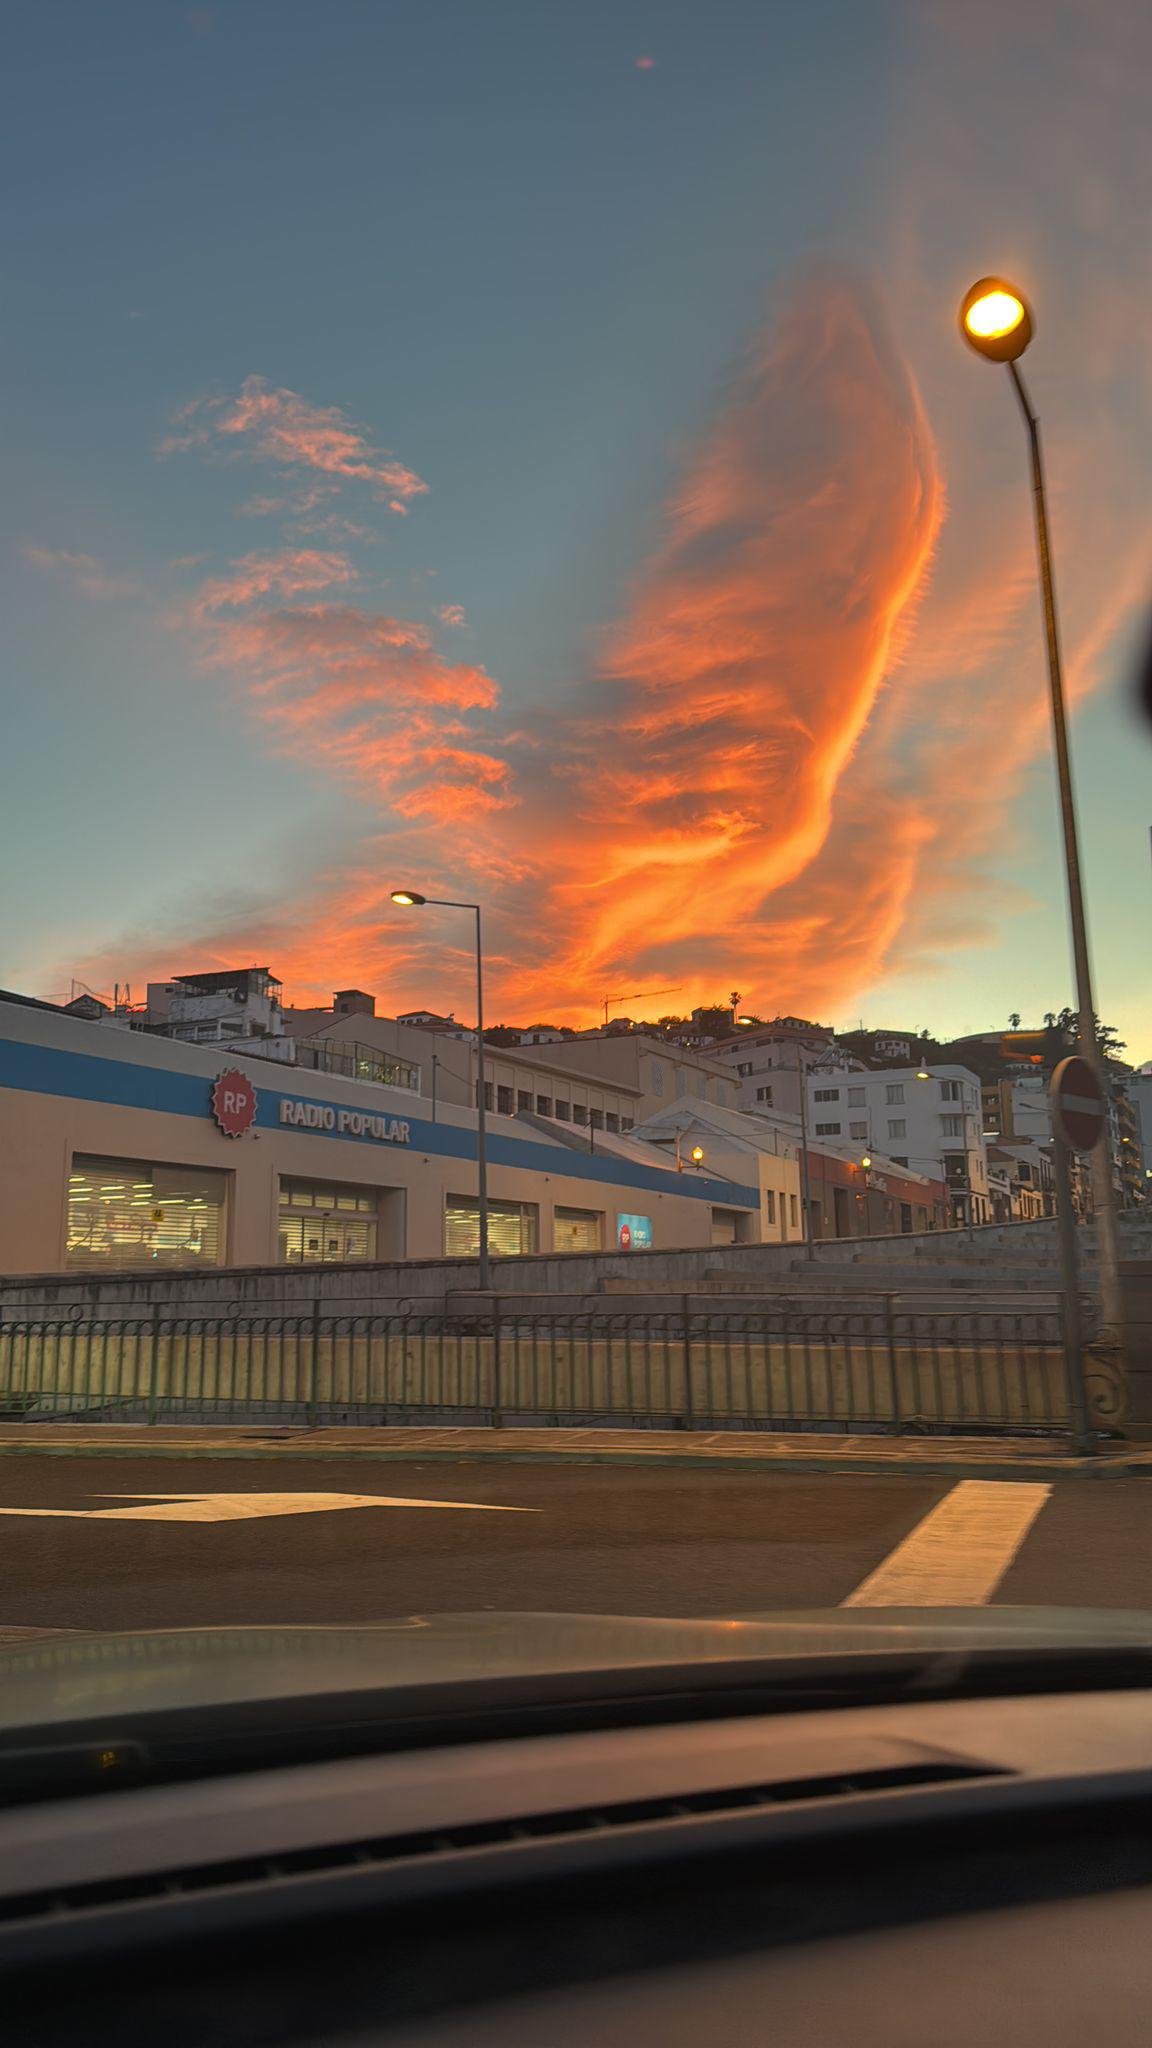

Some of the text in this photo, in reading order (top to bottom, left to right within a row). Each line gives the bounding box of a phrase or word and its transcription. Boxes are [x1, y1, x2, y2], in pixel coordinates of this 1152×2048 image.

[224, 1090, 247, 1114] RP
[280, 1099, 410, 1143] RADIO POPULAR
